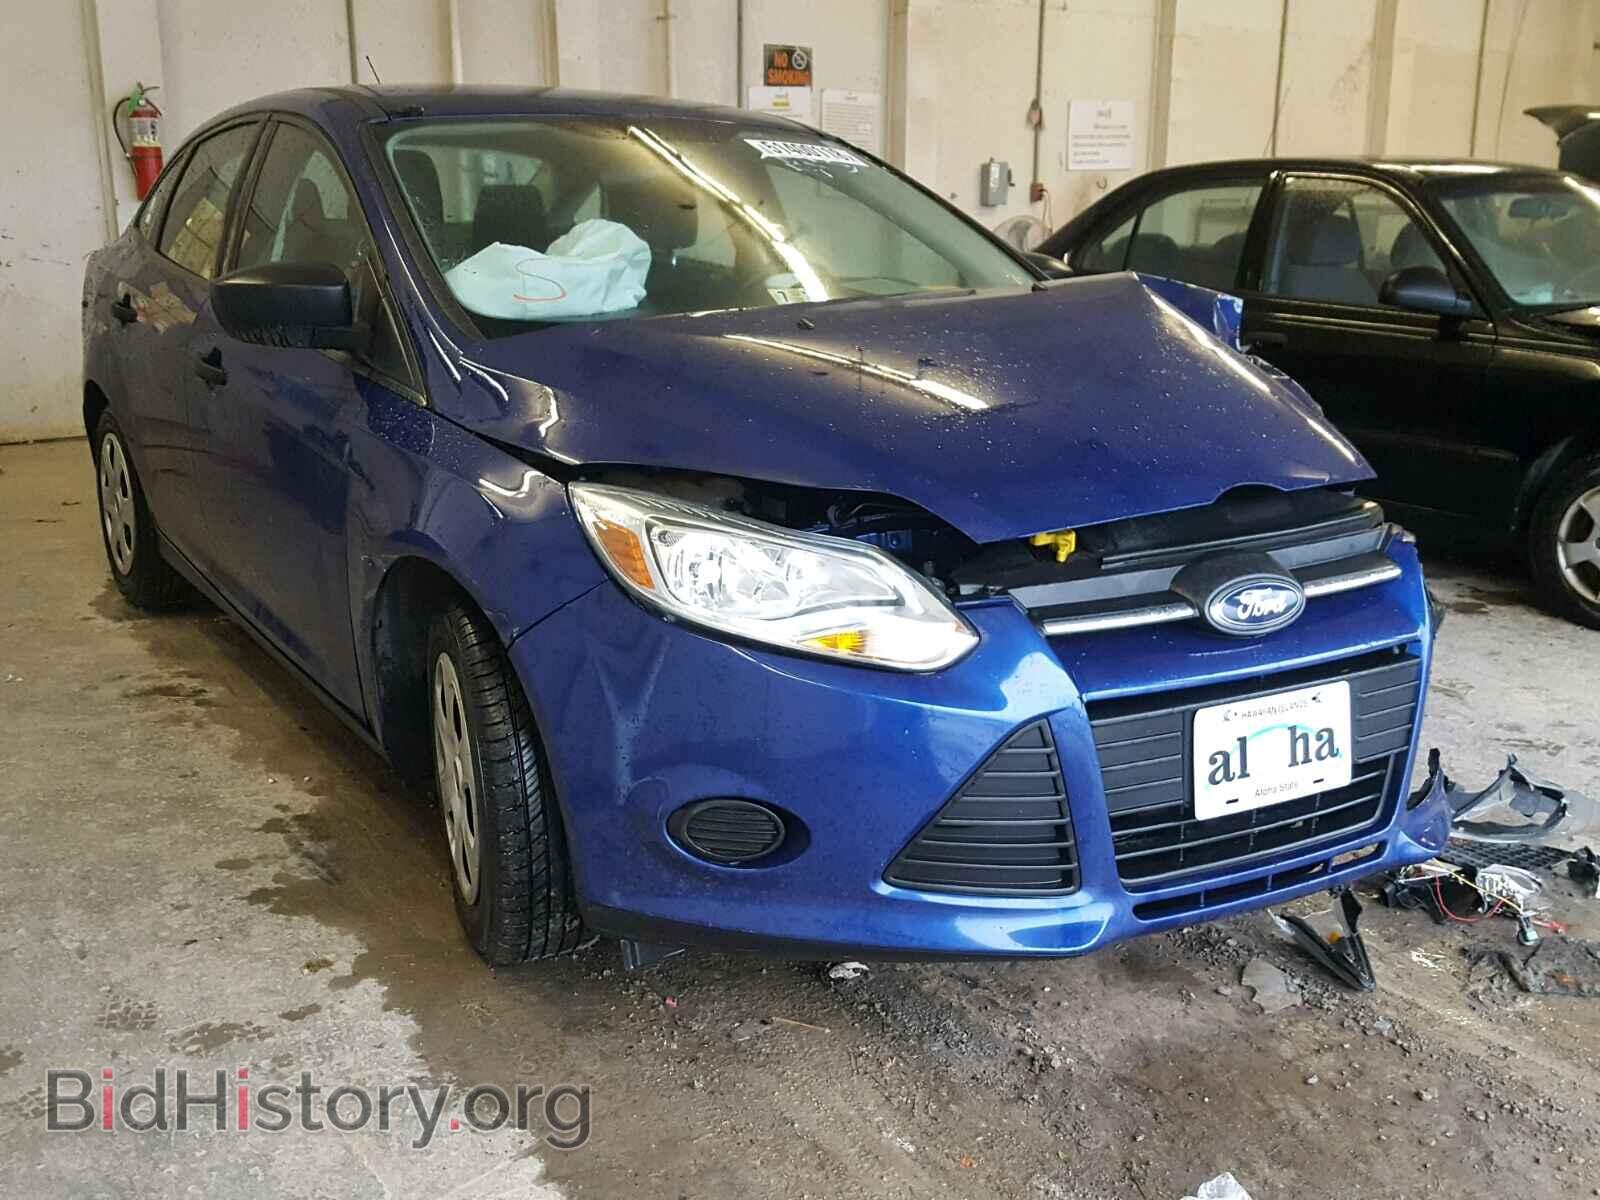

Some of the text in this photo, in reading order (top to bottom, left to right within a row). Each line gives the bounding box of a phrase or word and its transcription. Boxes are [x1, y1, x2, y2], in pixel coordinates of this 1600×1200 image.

[773, 51, 789, 67] NO
[768, 69, 810, 85] SMOKING
[512, 257, 567, 301] S
[1236, 588, 1288, 620] Ford
